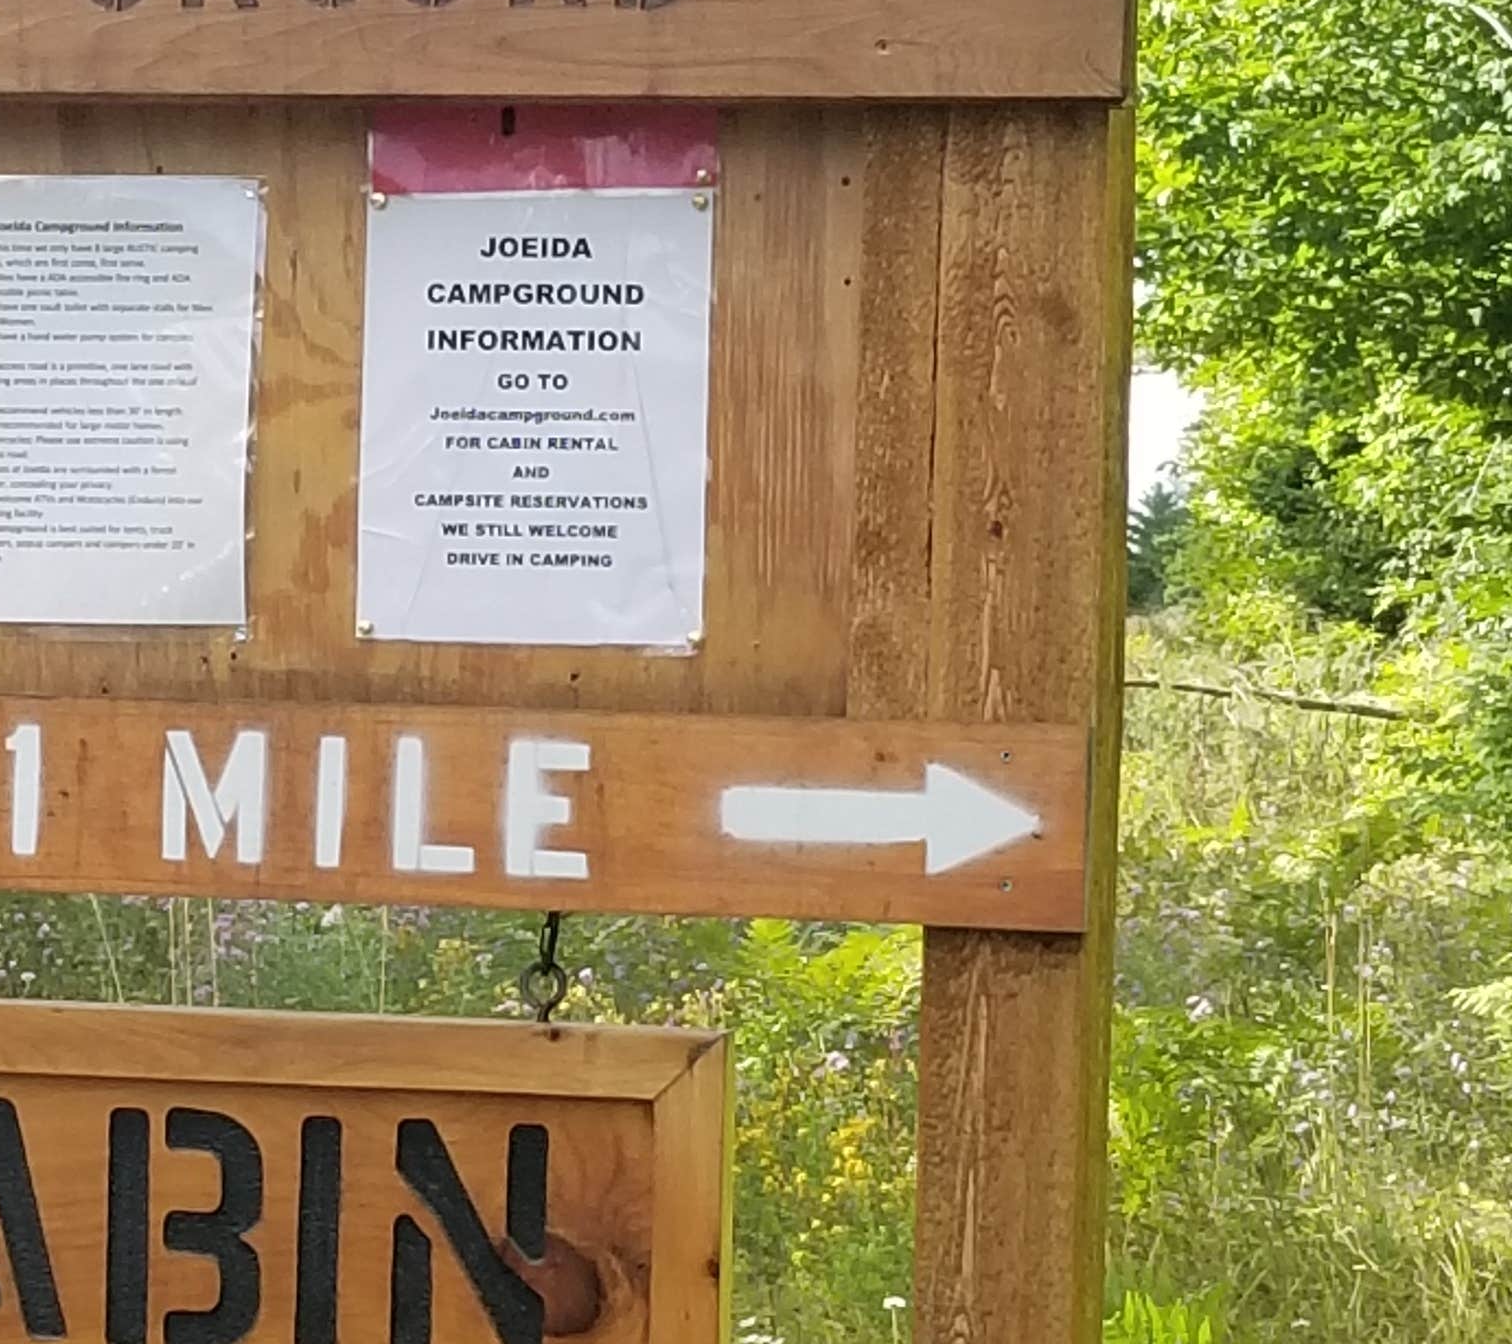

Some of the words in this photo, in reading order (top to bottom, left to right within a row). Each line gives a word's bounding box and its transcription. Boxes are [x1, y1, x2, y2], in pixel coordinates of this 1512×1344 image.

[34, 220, 110, 234] Campground
[113, 220, 184, 232] Information
[480, 237, 592, 259] JOEIDA
[426, 283, 645, 305] CAMPGROUND
[426, 329, 642, 352] INFORMATION
[497, 373, 530, 391] GO
[538, 373, 568, 391] TO
[430, 407, 636, 424] Joeidacampground.com
[445, 436, 481, 450] FOR
[487, 436, 542, 450] CABIN
[547, 437, 619, 451] RENTAL
[512, 466, 550, 479] AND
[414, 494, 504, 508] CAMPSITE
[510, 495, 648, 510] RESERVATIONS
[442, 523, 469, 537] WE
[475, 523, 523, 538] STILL
[529, 524, 618, 539] WELCOME
[447, 552, 500, 566] DRIVE
[506, 553, 524, 566] IN
[530, 554, 613, 568] CAMPING
[2, 722, 41, 857] 1
[161, 730, 595, 879] MILE
